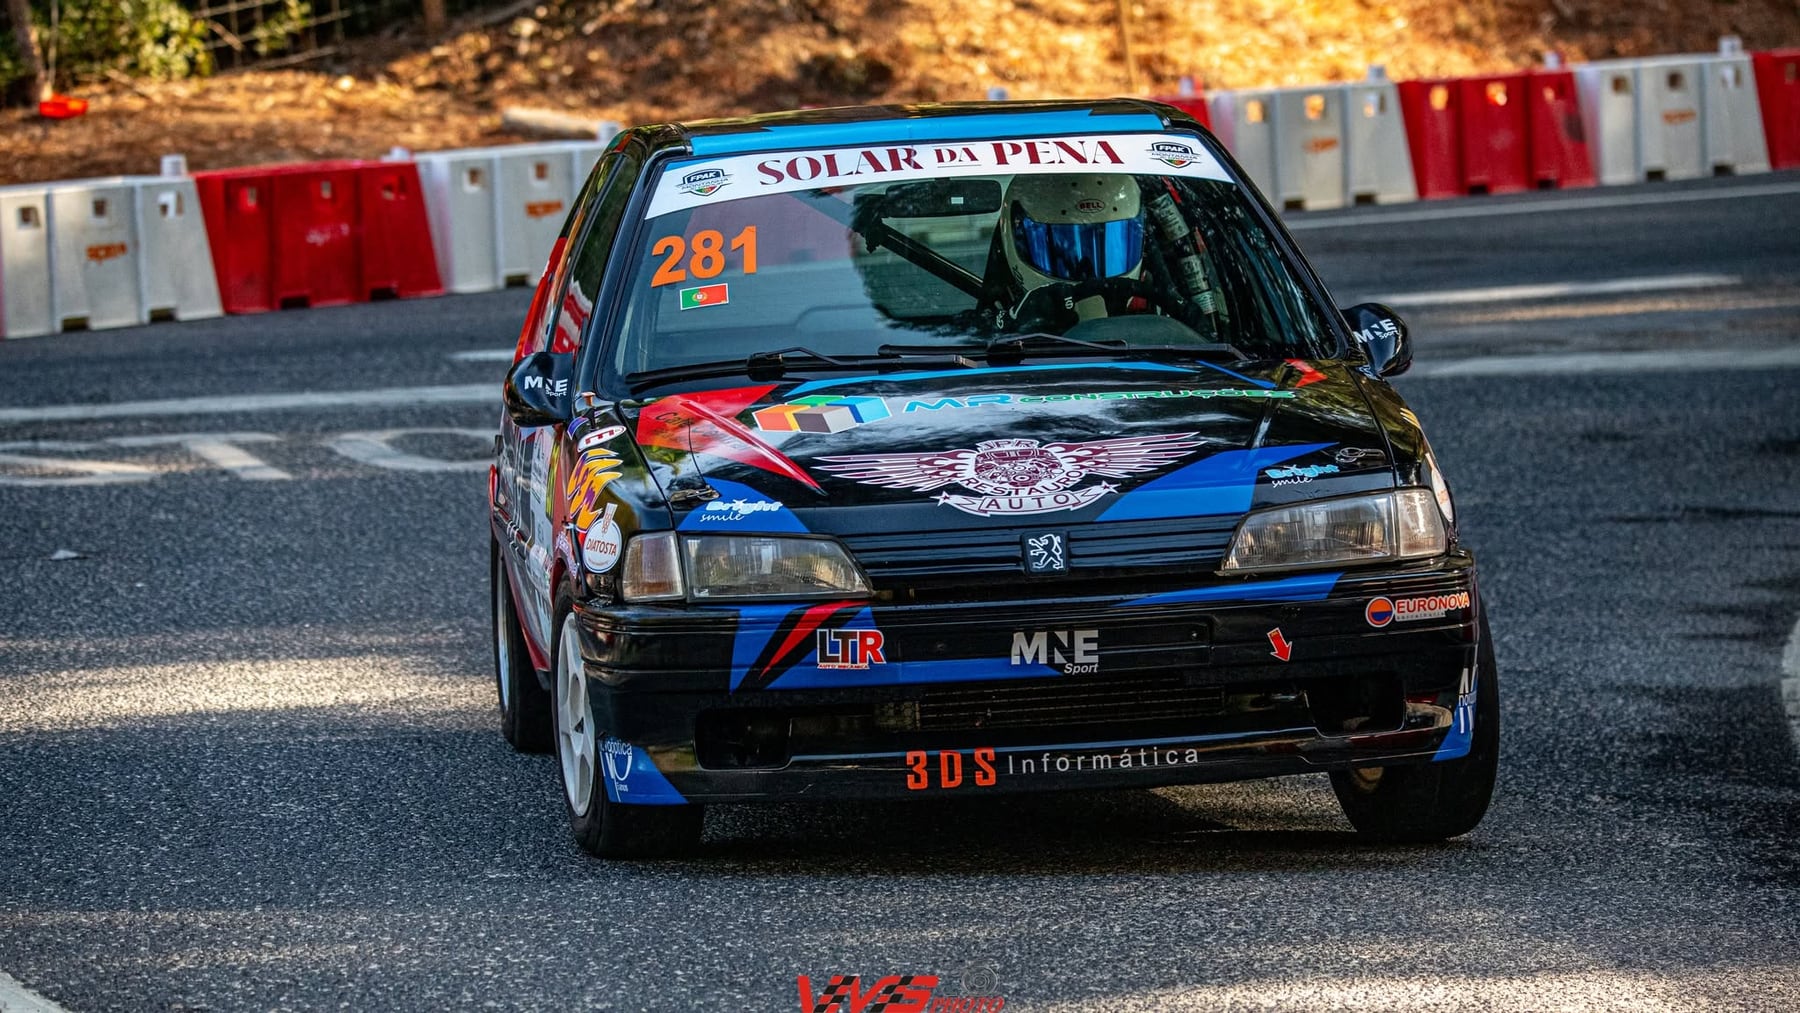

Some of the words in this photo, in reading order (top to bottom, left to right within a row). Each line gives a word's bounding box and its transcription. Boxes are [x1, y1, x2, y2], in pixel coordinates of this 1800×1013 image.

[1159, 145, 1185, 153] FPAK
[757, 146, 923, 186] SOLAR
[937, 147, 979, 165] DA
[991, 140, 1125, 166] PENA
[690, 171, 717, 181] FPAK
[650, 225, 757, 289] 281
[524, 375, 568, 392] MNE
[904, 393, 1013, 414] MR
[960, 470, 1083, 496] RESTAURO
[985, 493, 1070, 510] AUTO
[699, 511, 745, 522] smile
[586, 538, 617, 556] DIATOSTA
[1396, 592, 1470, 613] EURONOVA
[817, 629, 886, 664] LTR
[1011, 630, 1099, 665] MNE
[1063, 663, 1099, 675] Sport
[905, 746, 997, 790] 3DS
[1008, 746, 1199, 775] Informática
